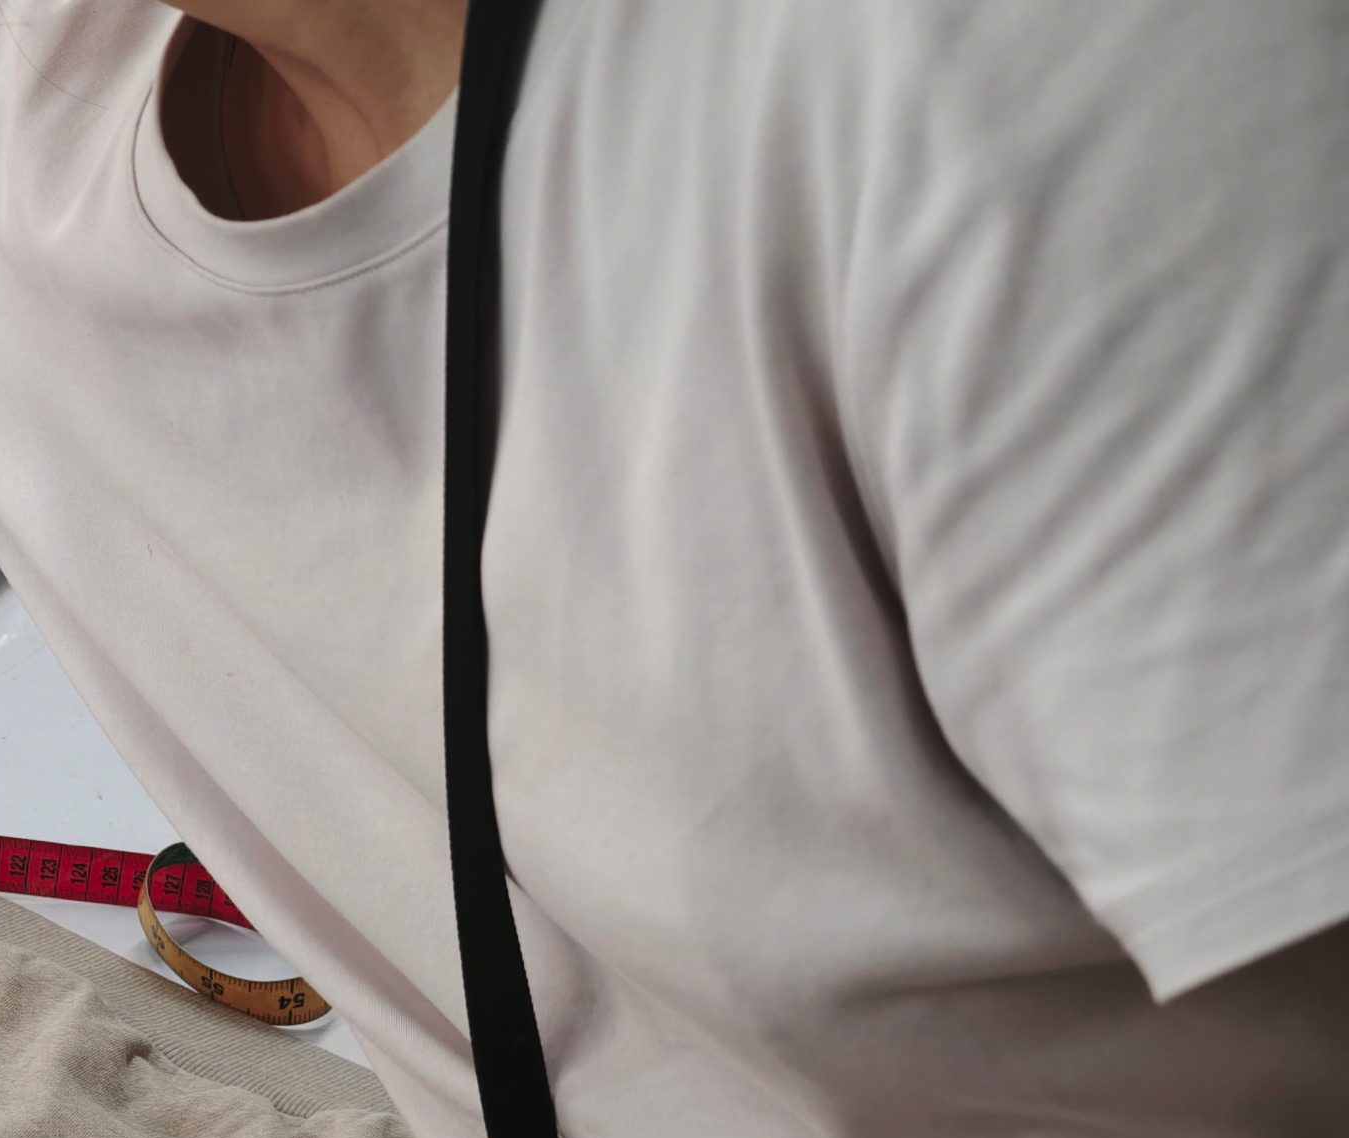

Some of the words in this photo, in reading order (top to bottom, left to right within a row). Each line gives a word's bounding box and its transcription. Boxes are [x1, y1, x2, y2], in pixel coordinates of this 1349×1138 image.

[10, 855, 27, 877] 122
[41, 859, 57, 880] 123
[70, 863, 87, 884] 124
[101, 866, 118, 888] 125
[164, 875, 180, 895] 127
[195, 880, 210, 899] 128
[201, 976, 224, 995] 55
[278, 993, 305, 1009] 54
